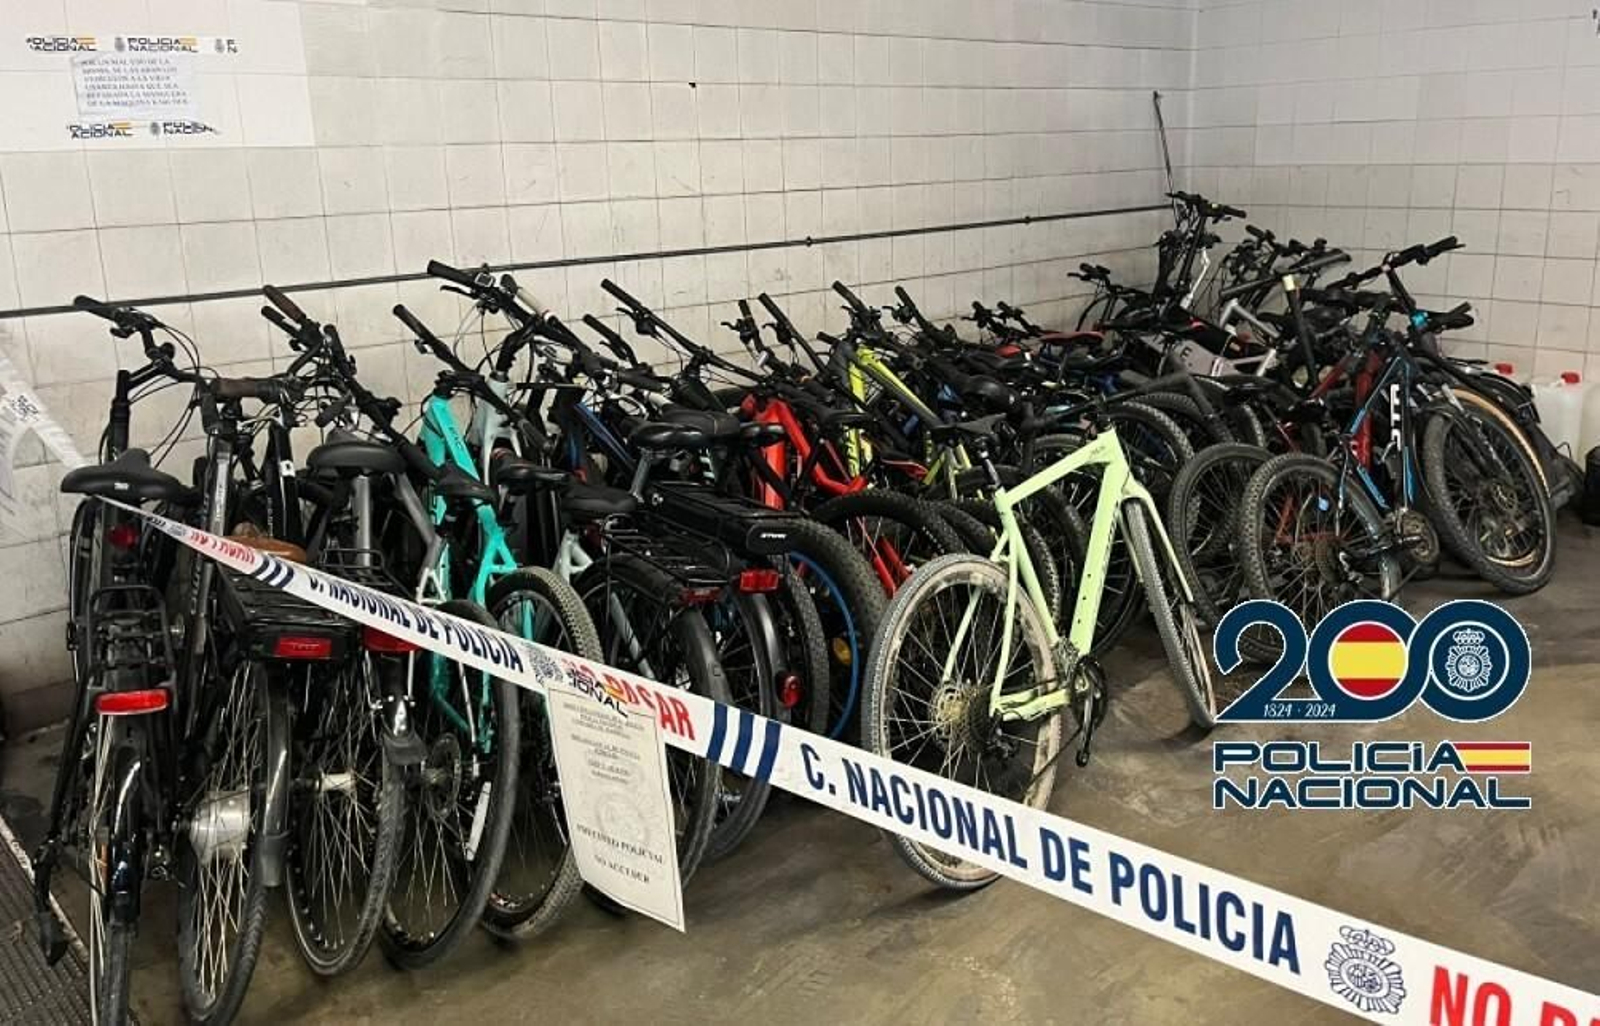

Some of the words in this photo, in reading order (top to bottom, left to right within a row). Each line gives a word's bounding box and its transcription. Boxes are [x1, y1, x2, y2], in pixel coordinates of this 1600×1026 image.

[128, 45, 198, 53] NACIONAL
[71, 129, 133, 139] ACIONAL
[800, 742, 837, 796] C.
[841, 757, 1029, 870] NACIONAL
[1039, 827, 1094, 896] DE
[1108, 850, 1301, 976] POLICIA
[1429, 965, 1513, 1026] NO
